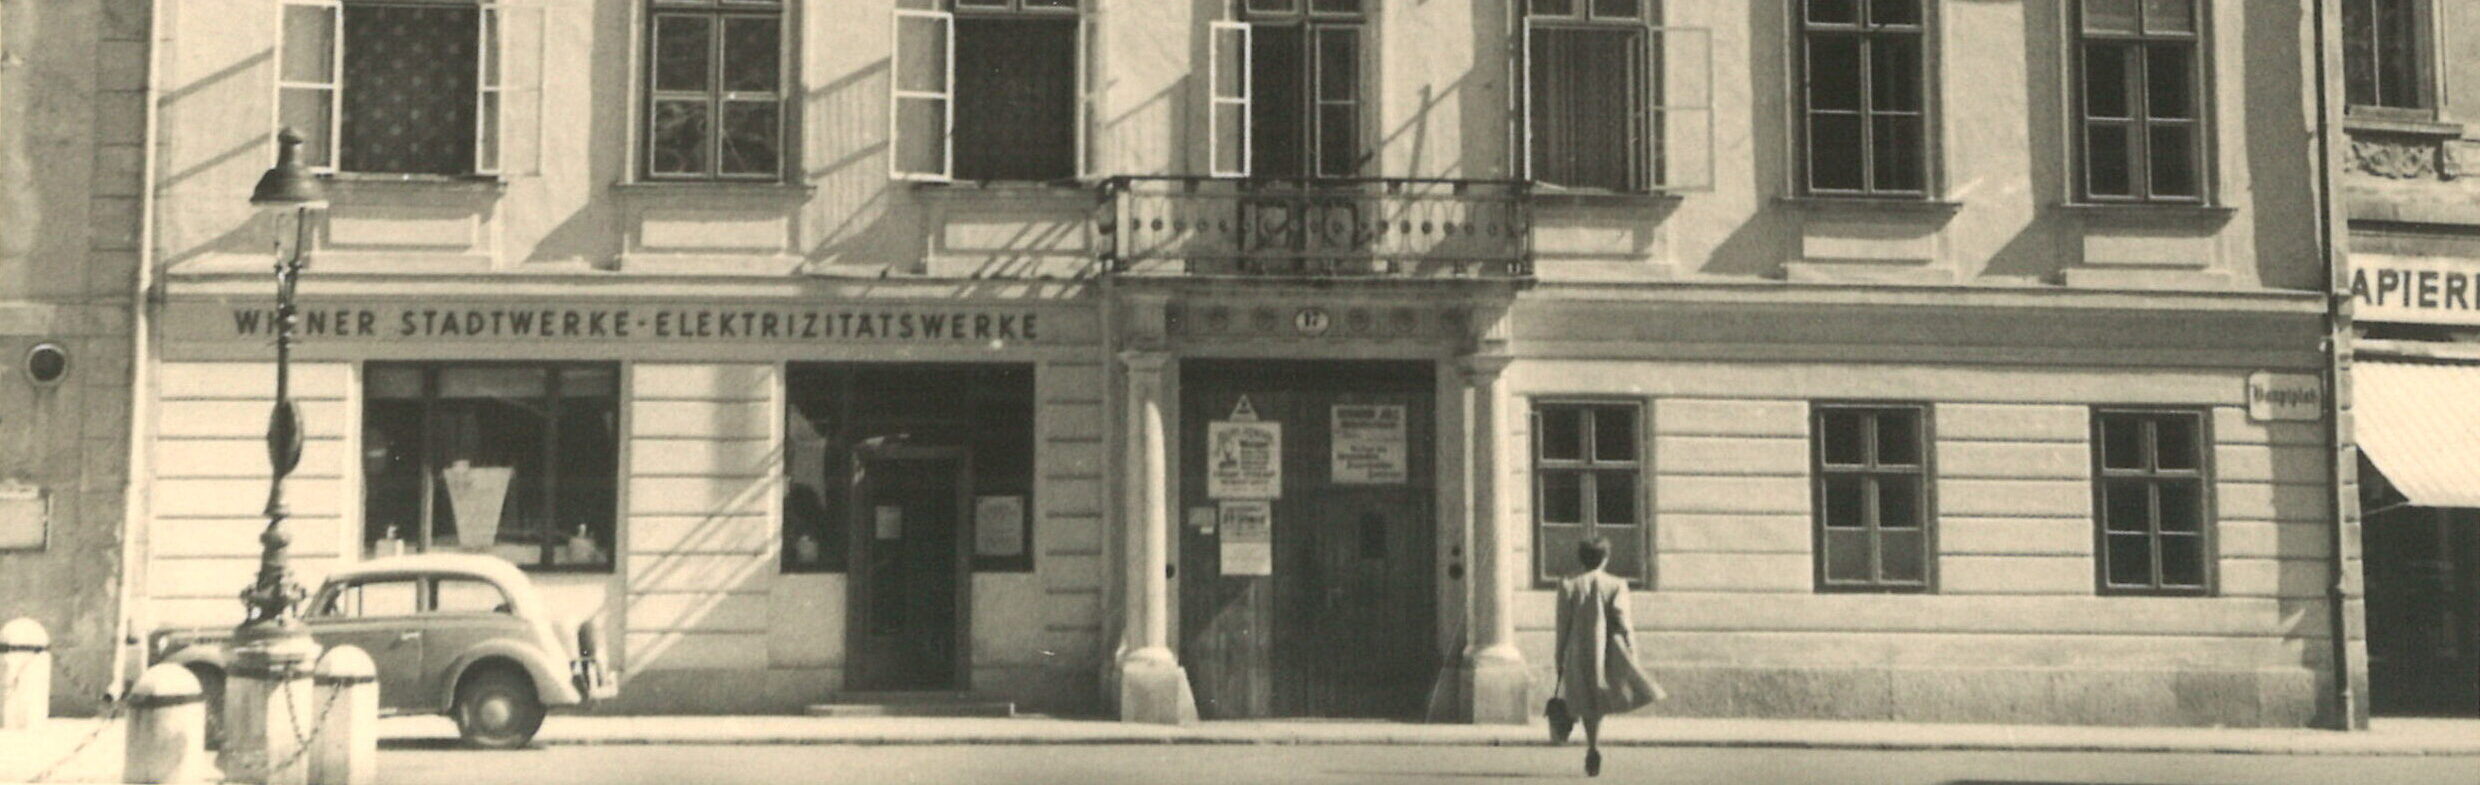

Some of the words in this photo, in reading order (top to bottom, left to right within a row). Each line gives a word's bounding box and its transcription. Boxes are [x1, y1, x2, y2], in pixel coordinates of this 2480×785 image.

[2351, 268, 2480, 311] APIER
[234, 310, 376, 335] WINER
[1304, 310, 1321, 327] 17
